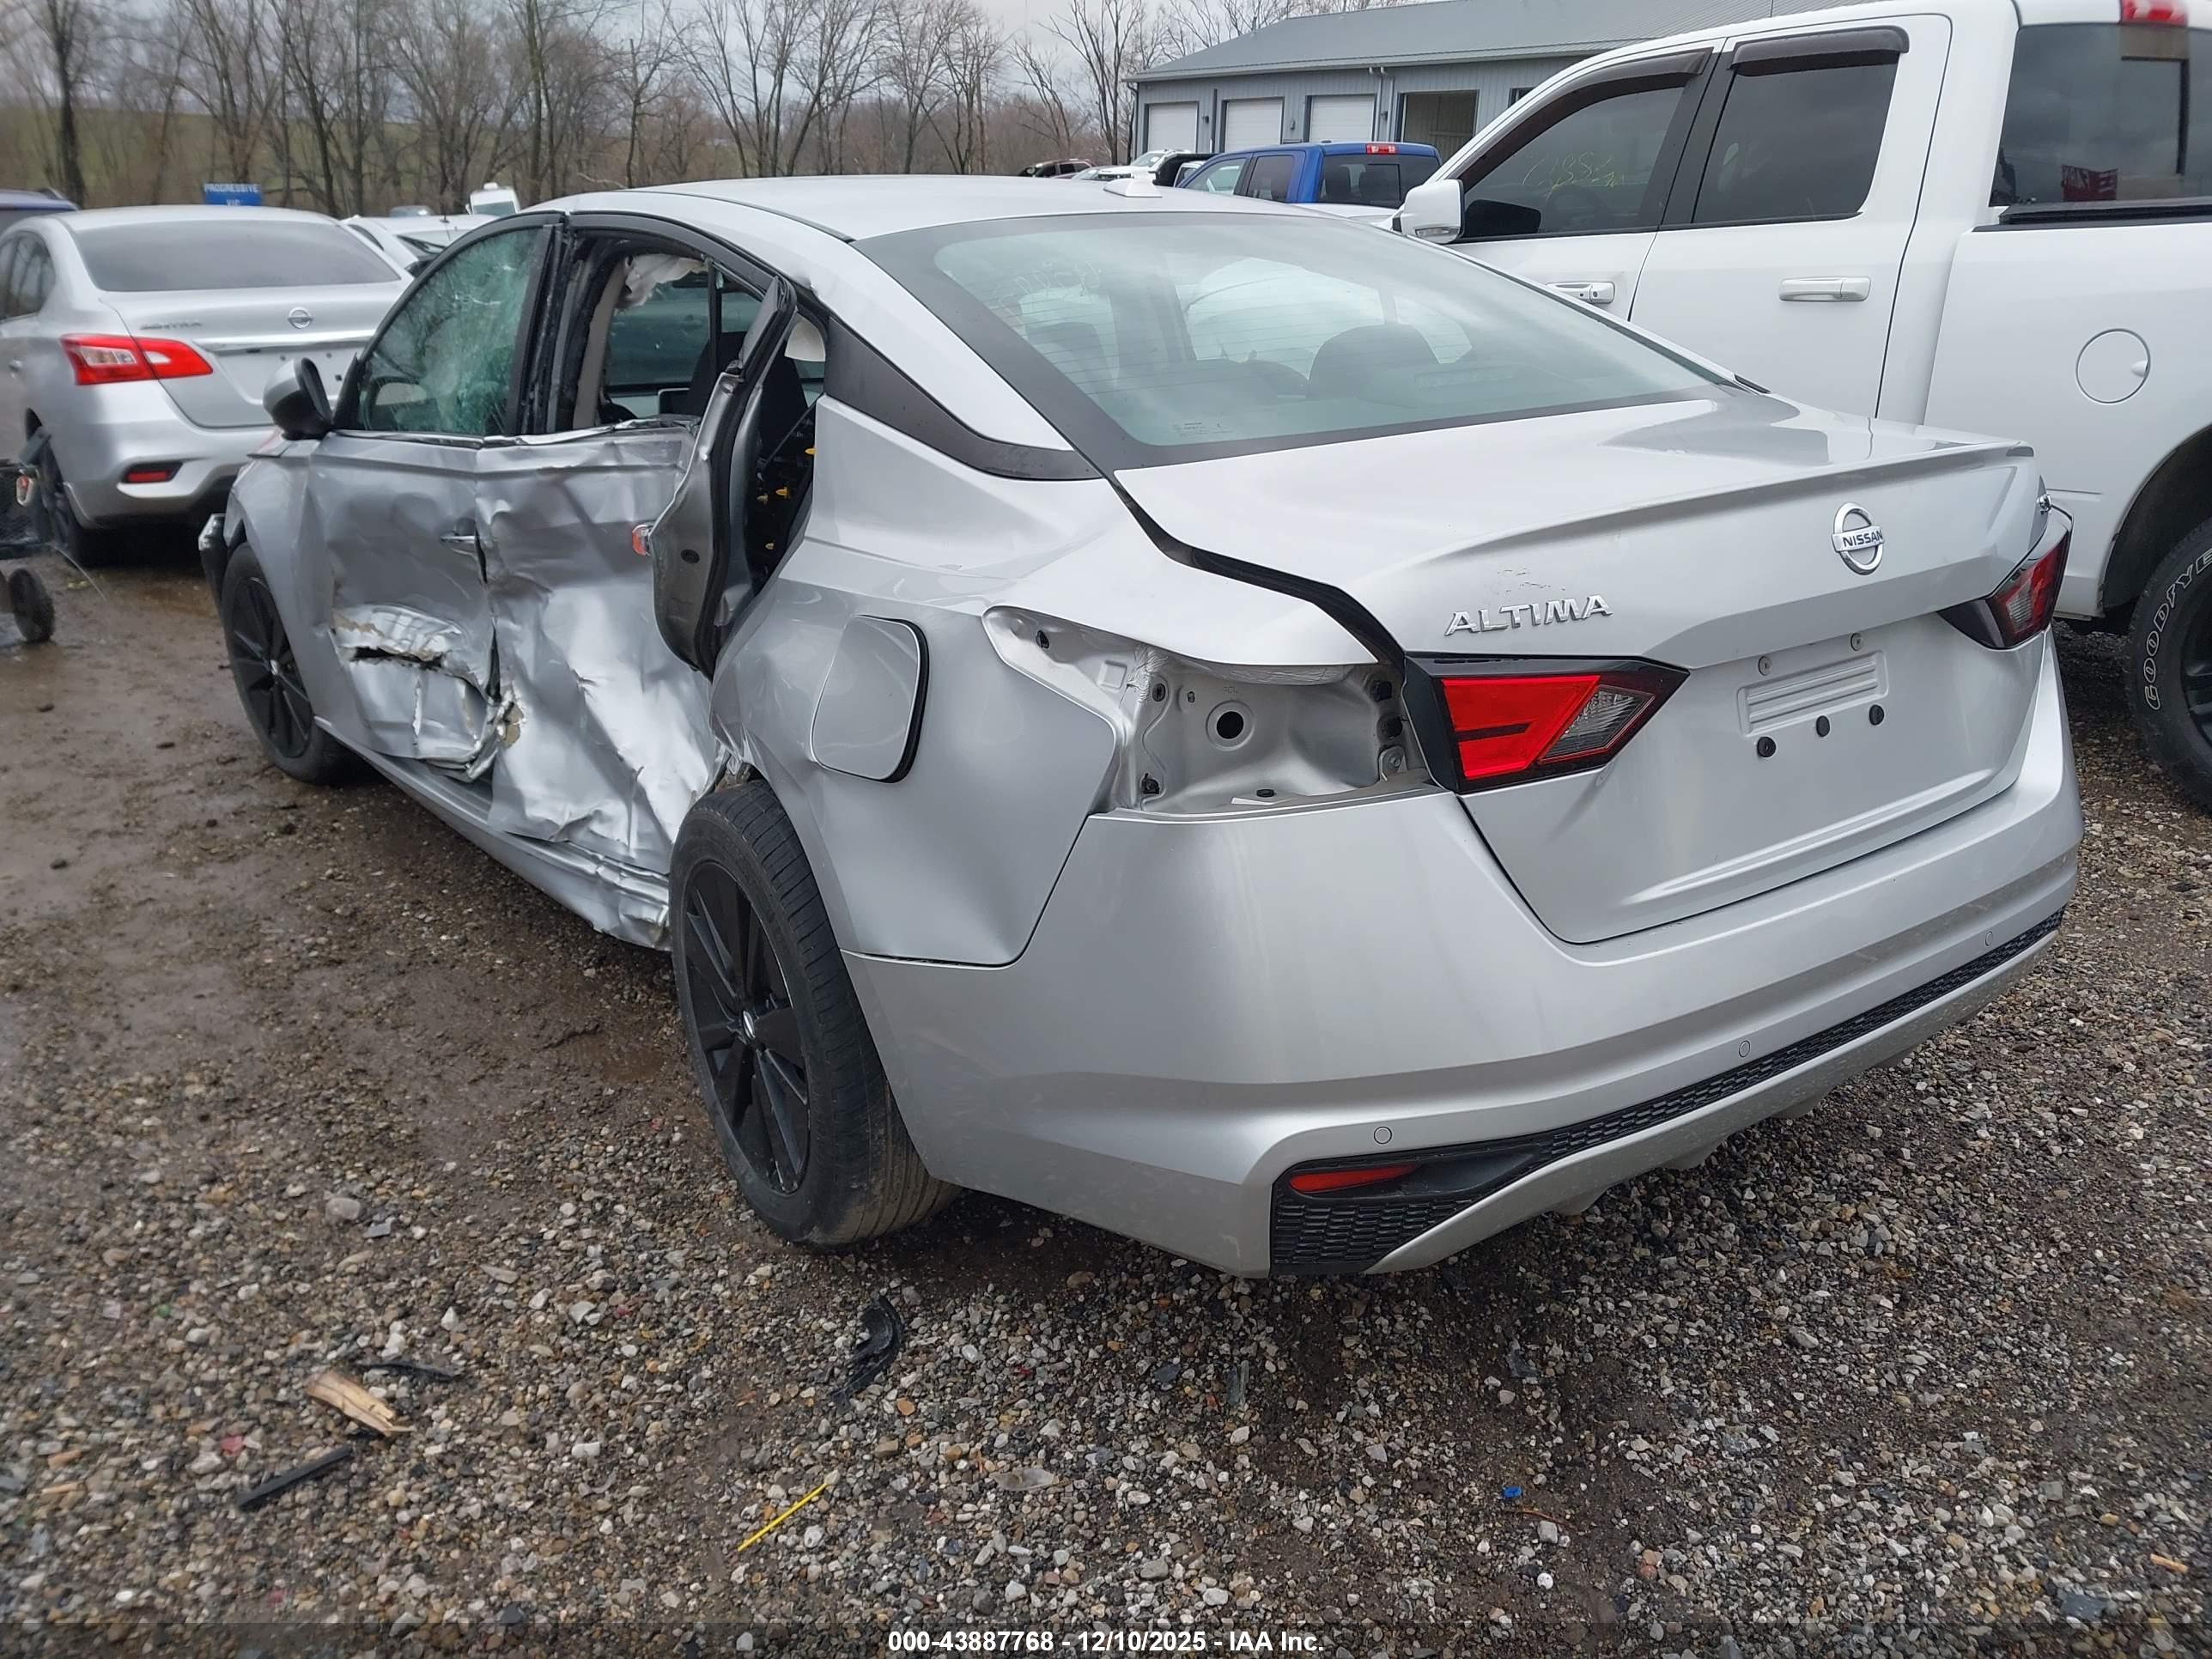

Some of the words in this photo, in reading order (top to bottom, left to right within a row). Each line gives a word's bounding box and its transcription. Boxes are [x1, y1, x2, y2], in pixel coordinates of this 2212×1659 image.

[204, 183, 261, 192] PROGRESSIVE
[1842, 529, 1883, 548] NISSAN
[1444, 593, 1613, 636] ALTIMA
